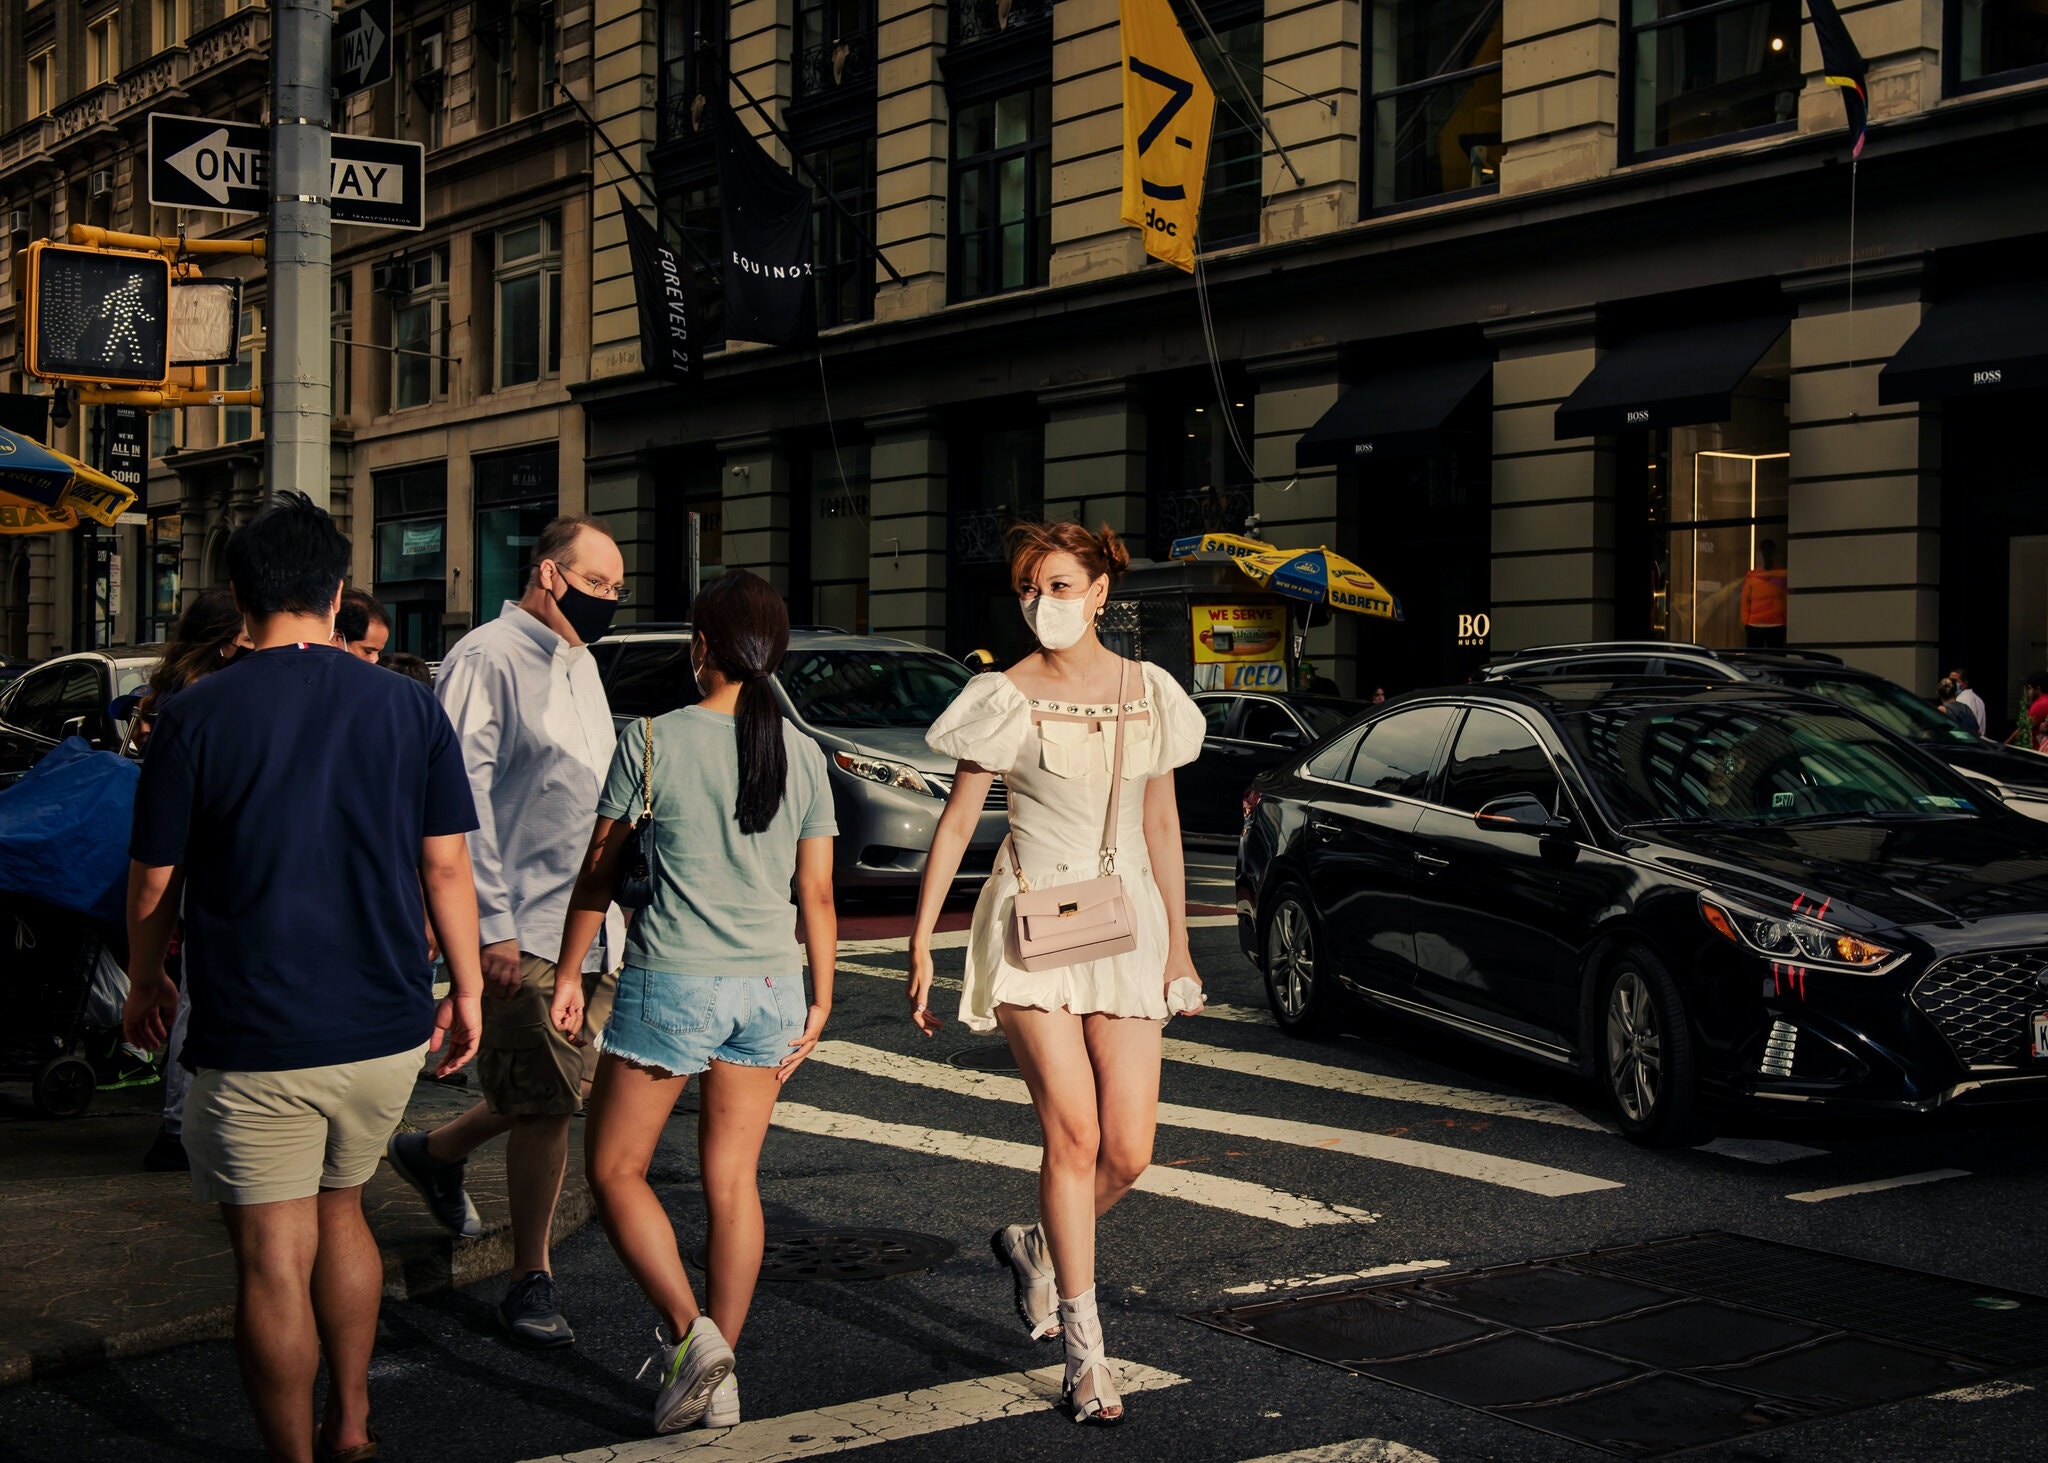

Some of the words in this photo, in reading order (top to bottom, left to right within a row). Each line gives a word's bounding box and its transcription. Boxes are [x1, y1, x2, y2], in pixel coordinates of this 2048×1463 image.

[344, 26, 374, 70] WAY
[196, 148, 269, 186] ONE
[331, 163, 388, 198] AY
[352, 213, 411, 224] TRANSPORTATION
[1145, 208, 1177, 237] doc
[732, 250, 813, 279] EQUINOX
[657, 247, 687, 341] FOREVER
[672, 348, 689, 374] 21
[1972, 369, 2001, 382] BOSS
[1627, 410, 1649, 421] BOSS
[111, 442, 130, 454] ALL
[131, 444, 141, 457] IN
[111, 469, 141, 484] SOHO
[1332, 590, 1390, 612] SABRETT
[1208, 609, 1229, 621] WE
[1232, 608, 1273, 621] SERVE
[1458, 613, 1490, 637] BO
[1458, 638, 1484, 646] HUGO
[1232, 665, 1283, 688] ICED
